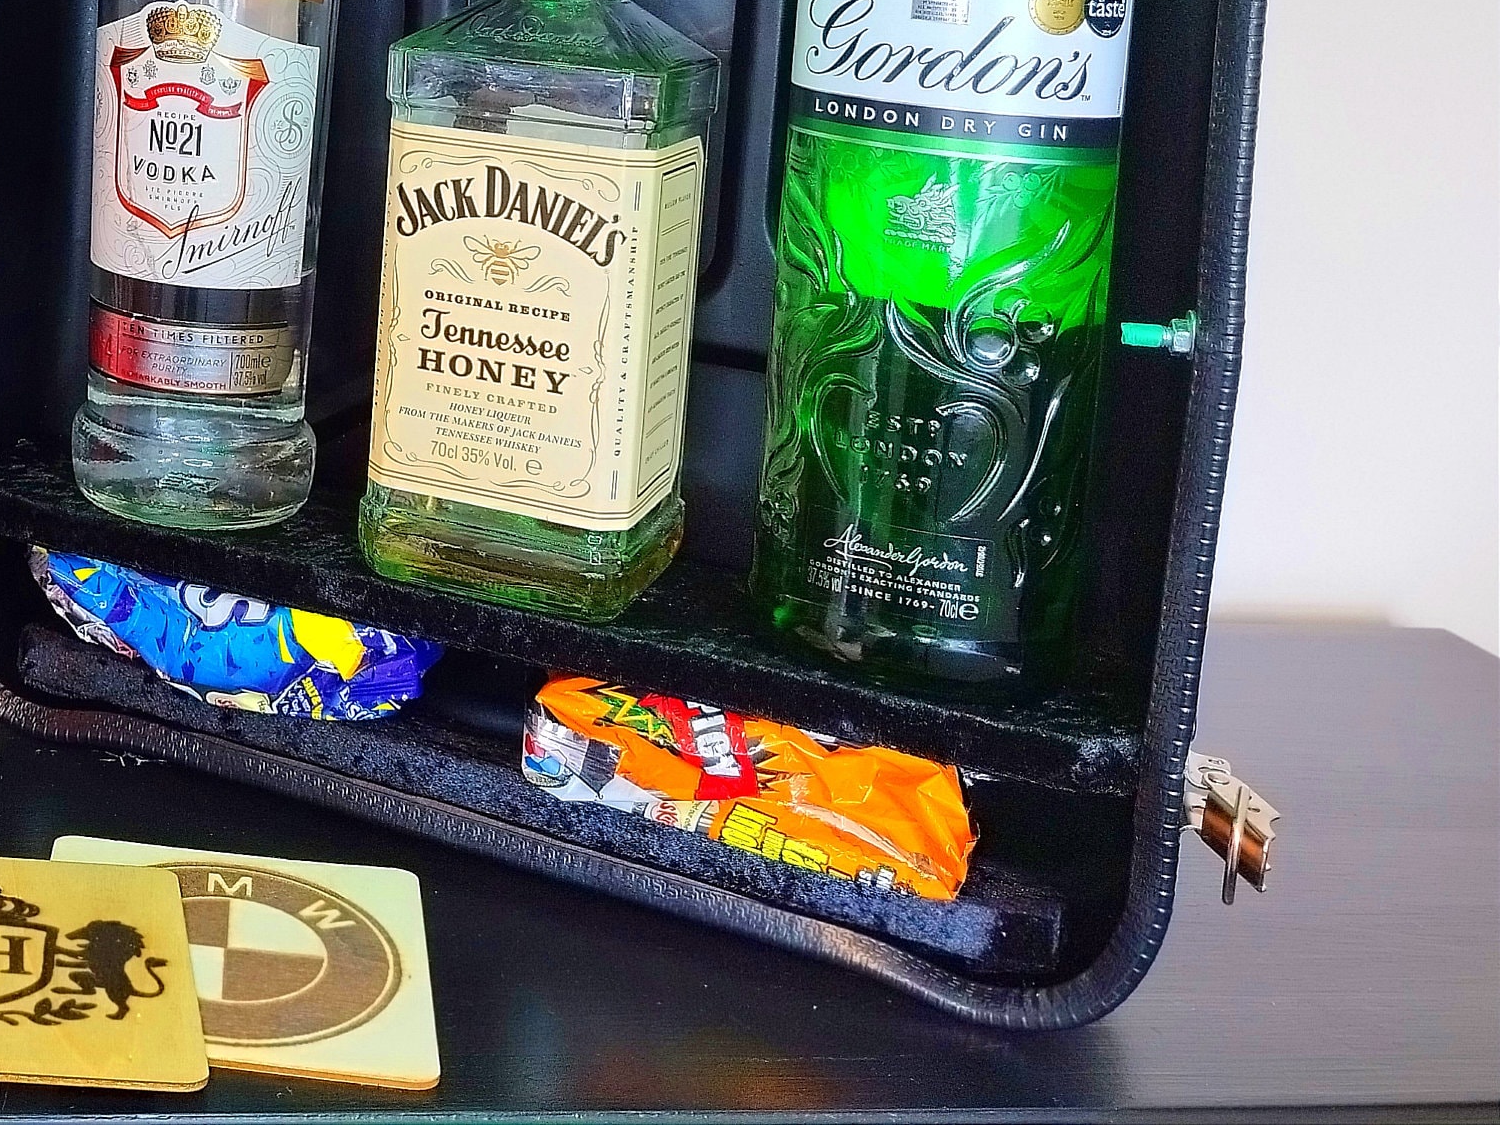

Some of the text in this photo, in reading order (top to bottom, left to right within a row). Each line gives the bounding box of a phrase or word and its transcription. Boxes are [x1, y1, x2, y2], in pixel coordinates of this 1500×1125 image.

[157, 111, 197, 122] RECIPE
[814, 97, 1068, 141] LONDON DRY GIN
[133, 155, 217, 184] VODKA
[161, 176, 301, 281] Smirnoff
[396, 164, 629, 268] JACK DANIEL'S
[424, 289, 572, 323] ORIGINAL RECIPE
[122, 321, 265, 345] TEN TIMES FILTERED
[420, 308, 571, 362] Tennessee
[613, 386, 627, 457] QUALITY
[621, 225, 639, 365] CRAFTSMANSHIP
[121, 345, 227, 367] FOR EXTRAORDINARY
[151, 362, 188, 374] PURITY
[417, 347, 571, 395] HONEY
[184, 380, 227, 391] SMOOTH
[426, 382, 558, 415] FINELY CRAFTED
[398, 405, 427, 419] FROM
[429, 411, 451, 424] THE
[451, 416, 495, 432] MAKERS
[496, 424, 511, 434] OF
[510, 426, 537, 442] JACK
[449, 402, 532, 426] HONEY LIQUEUR
[430, 440, 459, 461] 70cl
[461, 446, 491, 467] 35%
[494, 451, 518, 473] Vol.
[435, 426, 542, 455] TENNESSEE WHISKEY
[826, 555, 961, 593] DISTILLED TO ALEXANDER
[859, 574, 913, 593] EXACTING
[916, 586, 981, 603] STANDARDS
